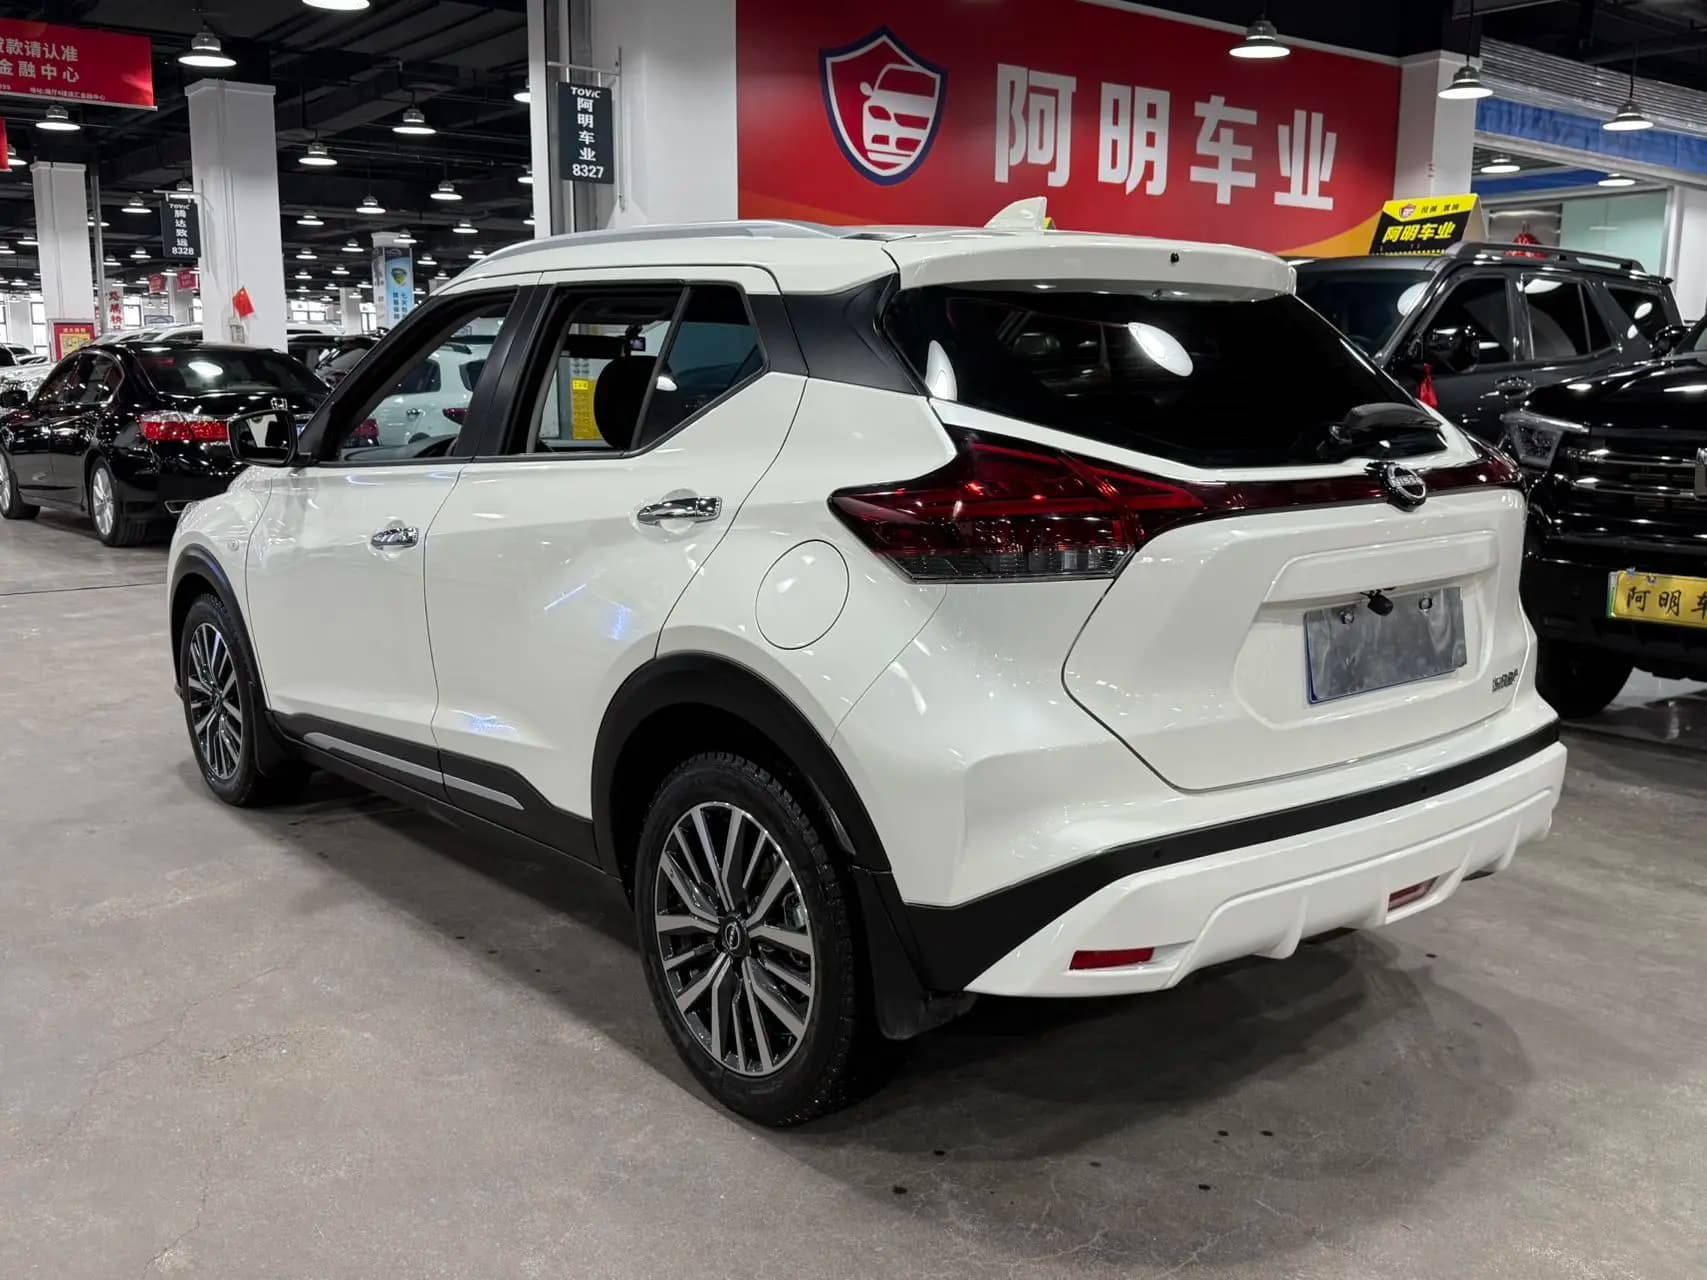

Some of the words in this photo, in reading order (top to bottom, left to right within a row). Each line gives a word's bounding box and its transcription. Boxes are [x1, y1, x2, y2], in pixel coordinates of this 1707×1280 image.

[0, 36, 79, 62] 款请认准
[0, 58, 80, 83] 金融中心
[577, 97, 596, 161] 阿明车业
[994, 63, 1337, 211] 阿明车业
[572, 163, 604, 178] 8327
[1381, 221, 1456, 243] 阿明车业
[171, 246, 194, 255] 8328
[1626, 586, 1707, 621] 阿明车
